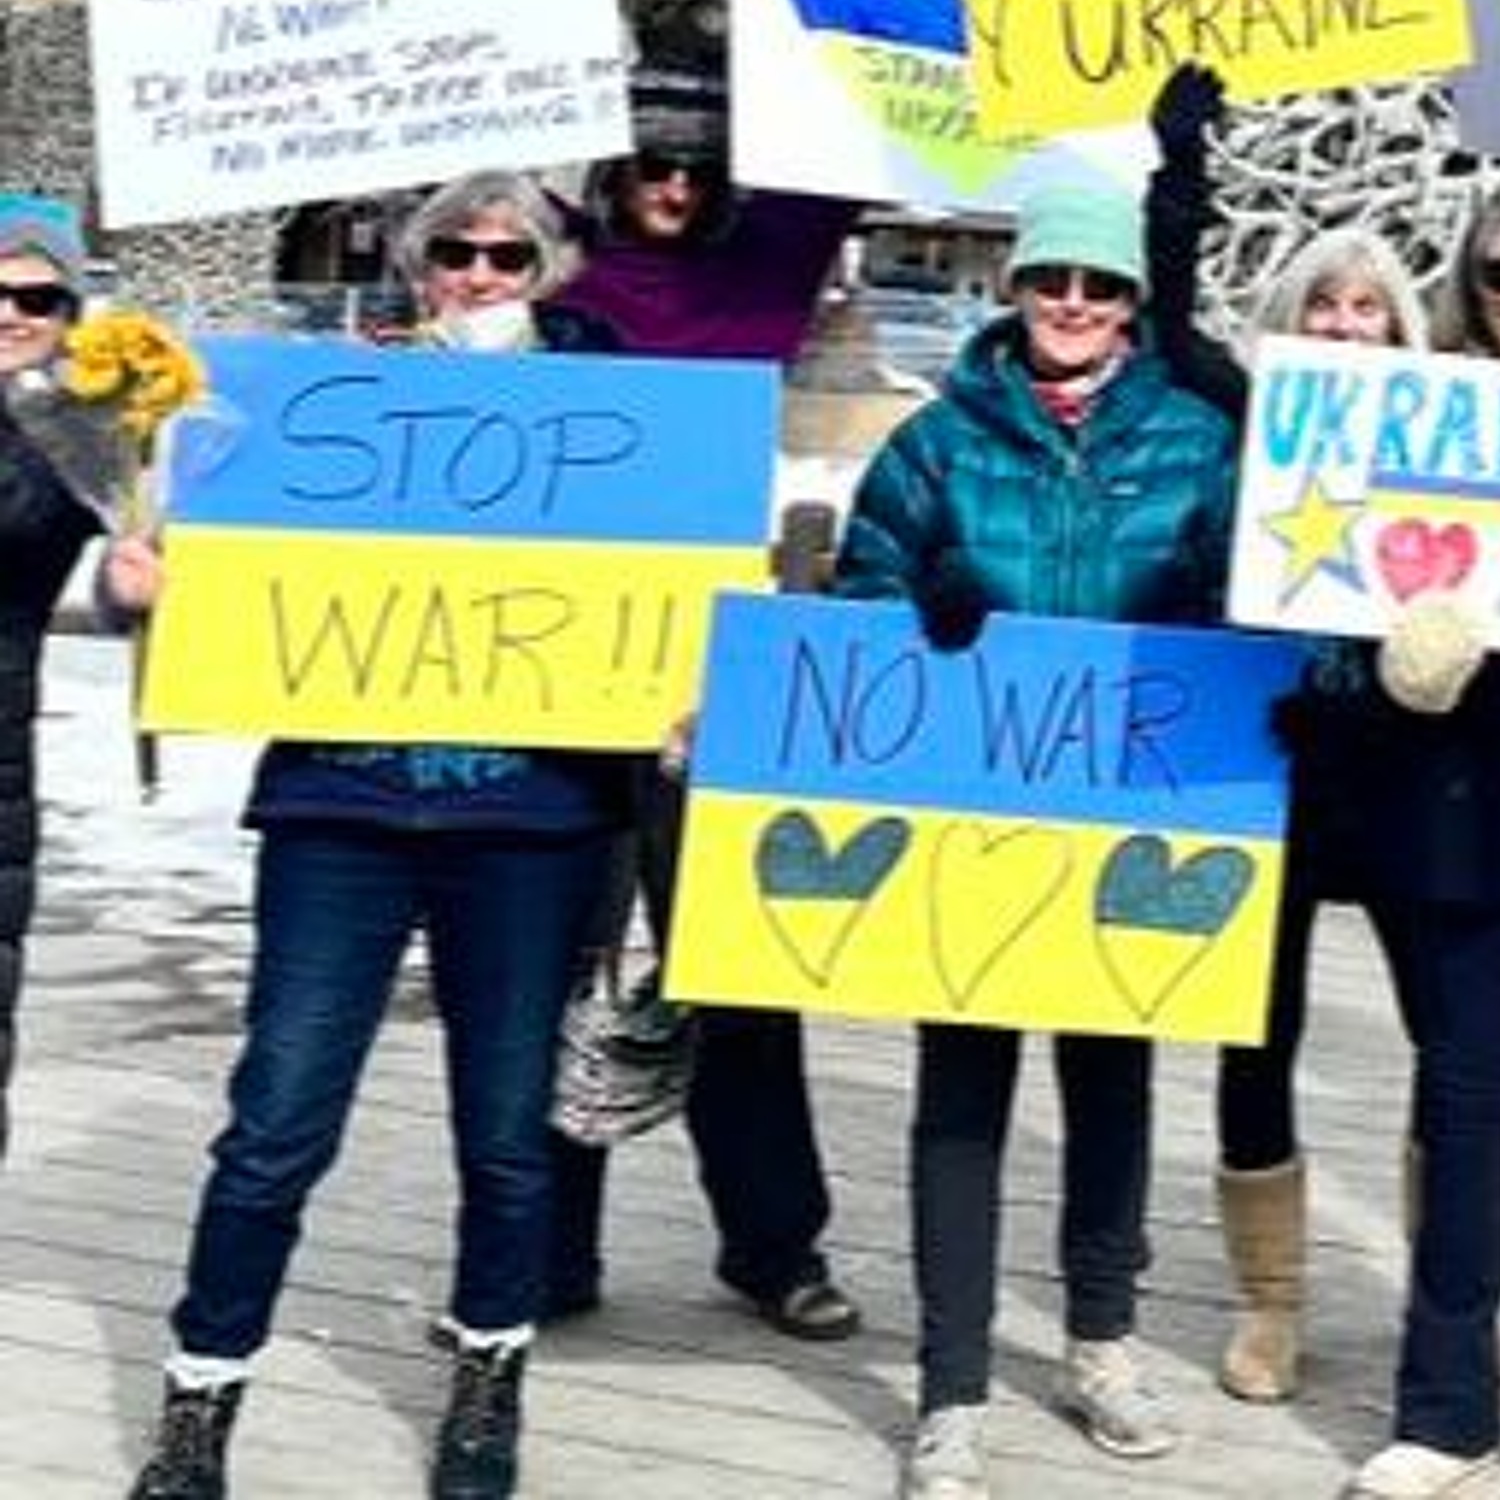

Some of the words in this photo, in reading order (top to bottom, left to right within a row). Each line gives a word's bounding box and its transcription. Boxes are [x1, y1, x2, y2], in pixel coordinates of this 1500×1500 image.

[278, 374, 644, 517] STOP
[778, 634, 926, 769] NO
[970, 652, 1192, 792] WAR
